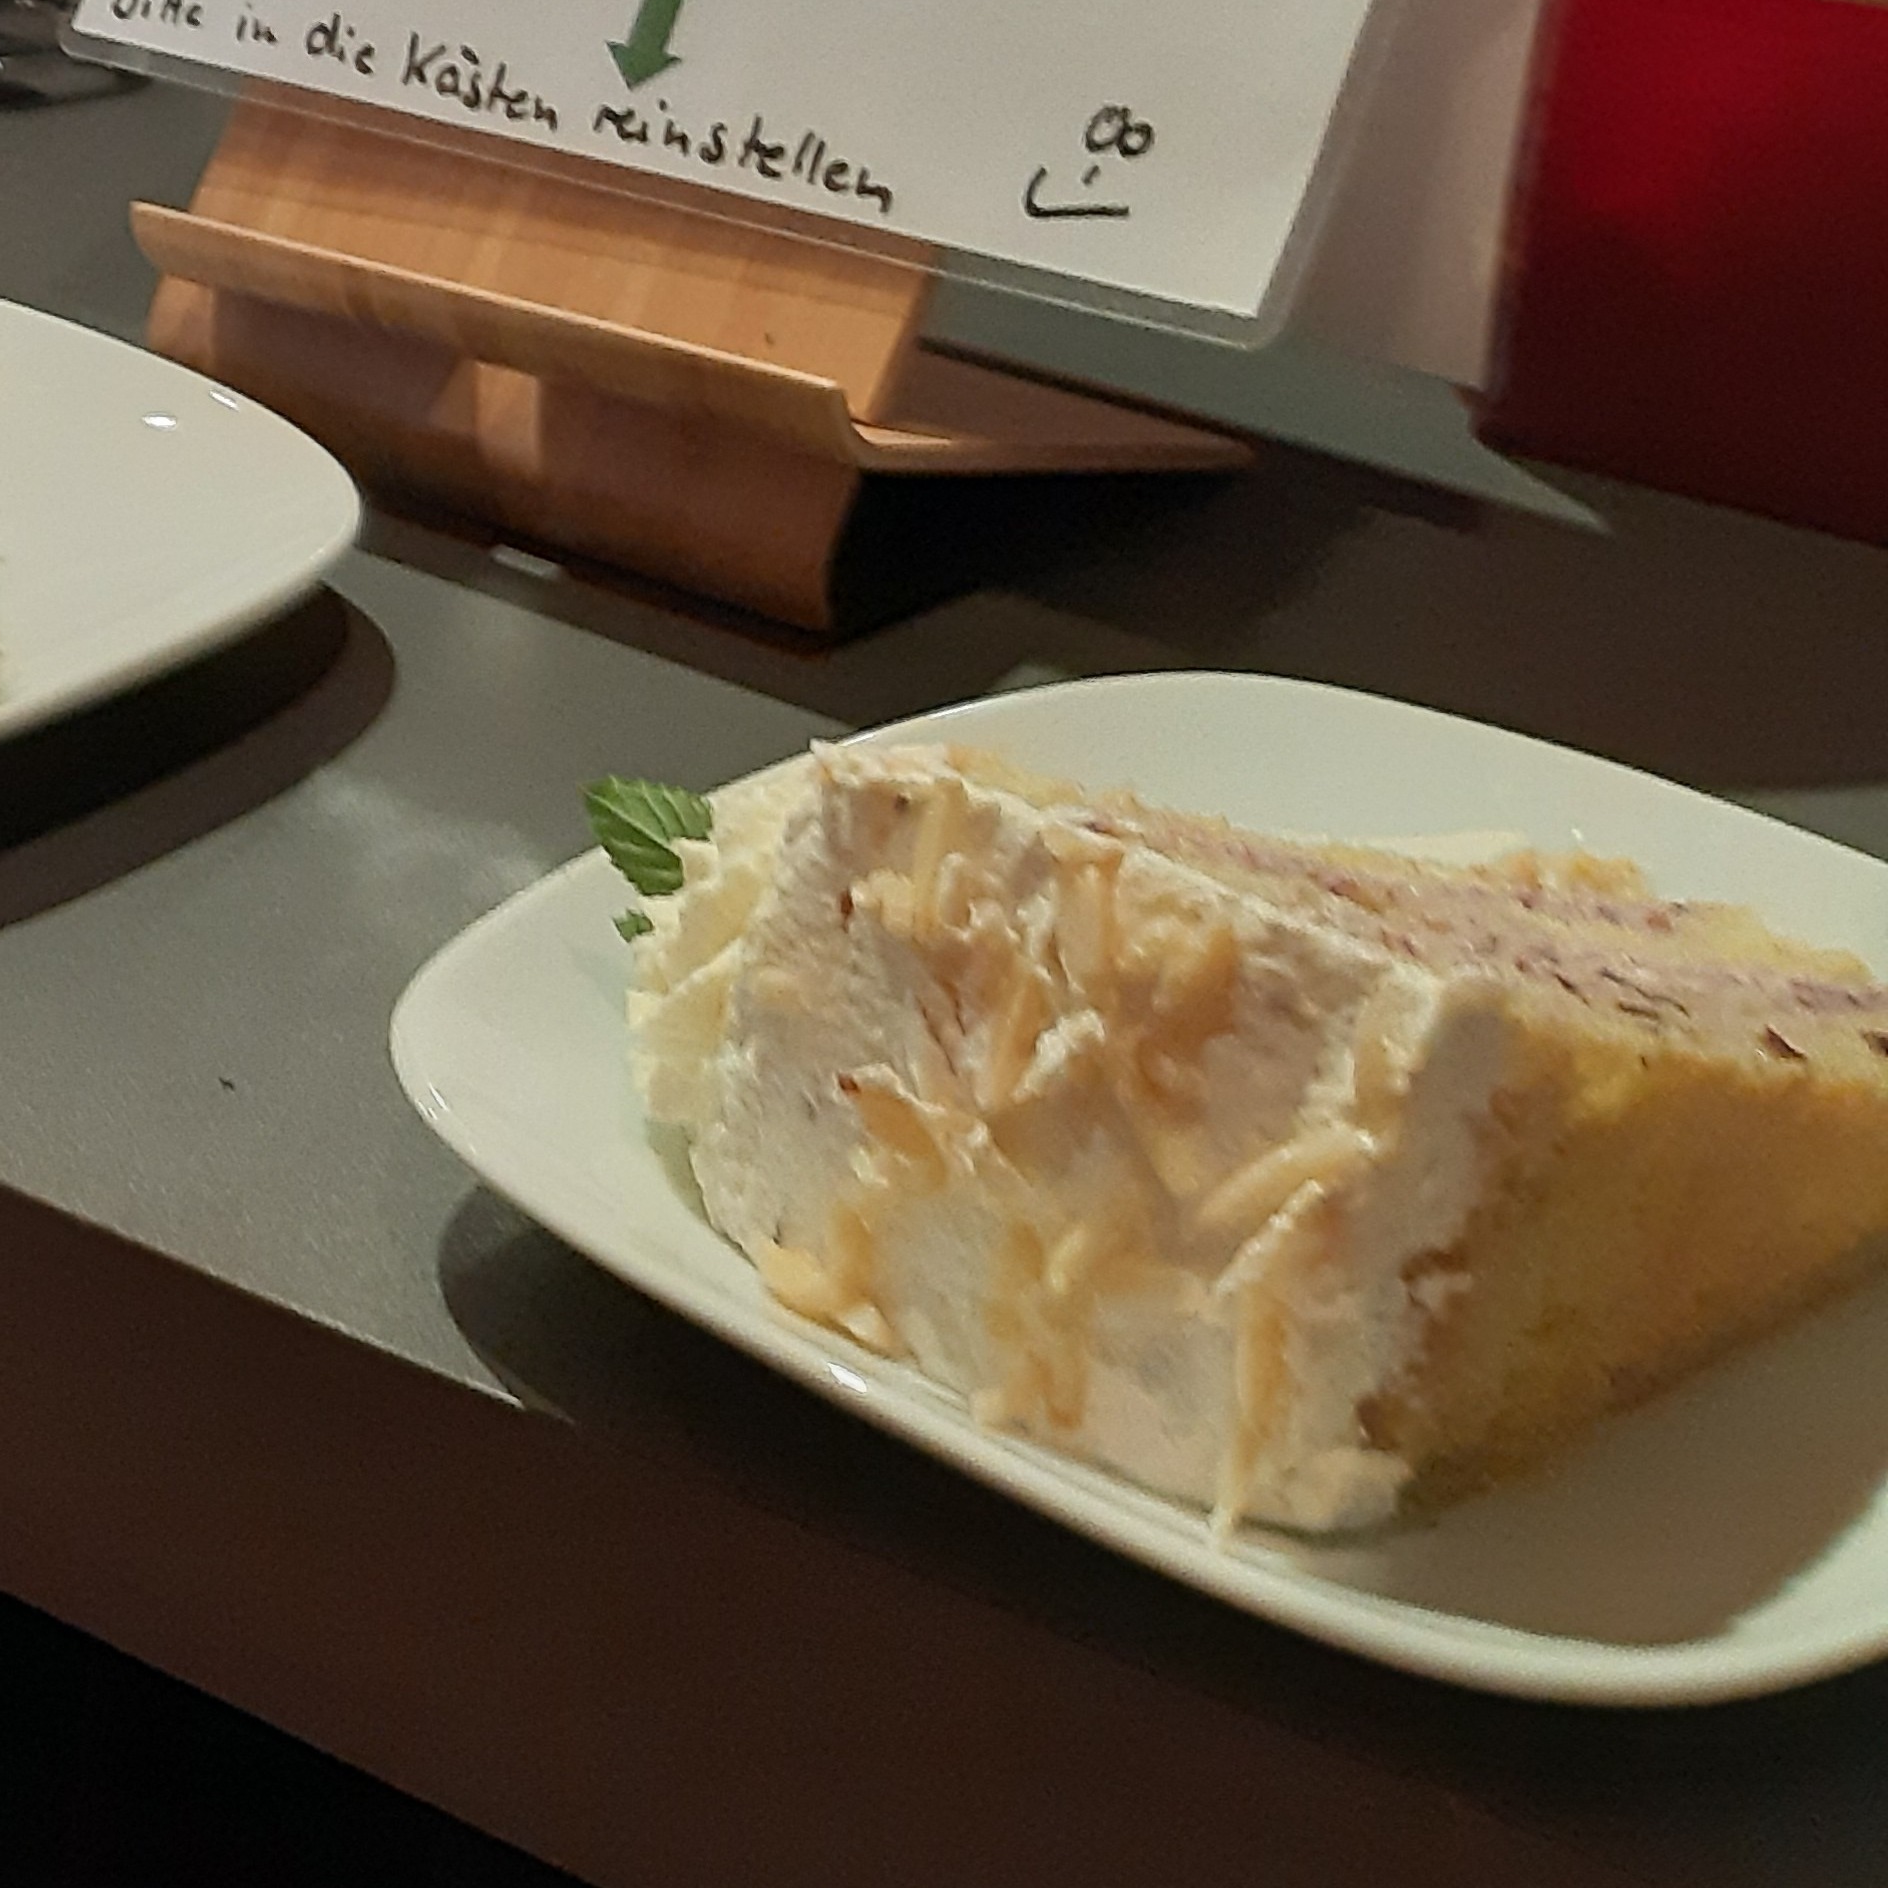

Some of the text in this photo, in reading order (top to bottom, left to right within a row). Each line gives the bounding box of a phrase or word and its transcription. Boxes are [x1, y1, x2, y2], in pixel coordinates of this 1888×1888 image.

[235, 2, 279, 45] in
[305, 12, 377, 76] die
[400, 29, 559, 131] Kästen
[592, 98, 894, 216] reinstellen
